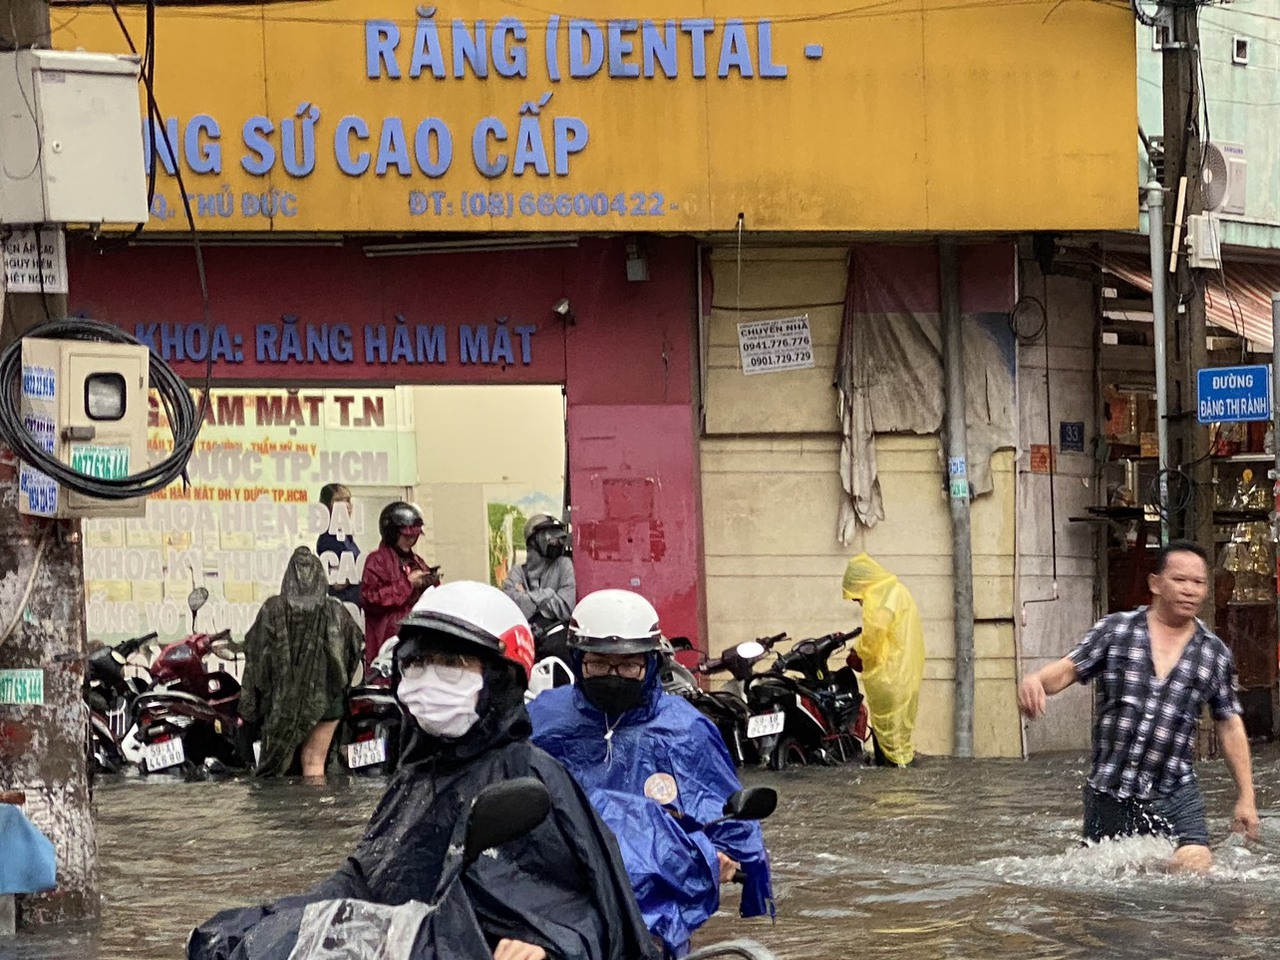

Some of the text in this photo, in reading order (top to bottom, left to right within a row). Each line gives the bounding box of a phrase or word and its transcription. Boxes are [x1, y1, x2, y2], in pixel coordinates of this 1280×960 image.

[365, 5, 528, 79] RĂNG
[544, 15, 788, 81] (DENTAL
[241, 102, 321, 178] SỨ
[334, 116, 453, 179] CAO
[472, 92, 589, 179] CẤP
[135, 313, 537, 371] KHOA: RĂNG HÀM MẶT
[1212, 372, 1254, 390] ĐƯỜNG
